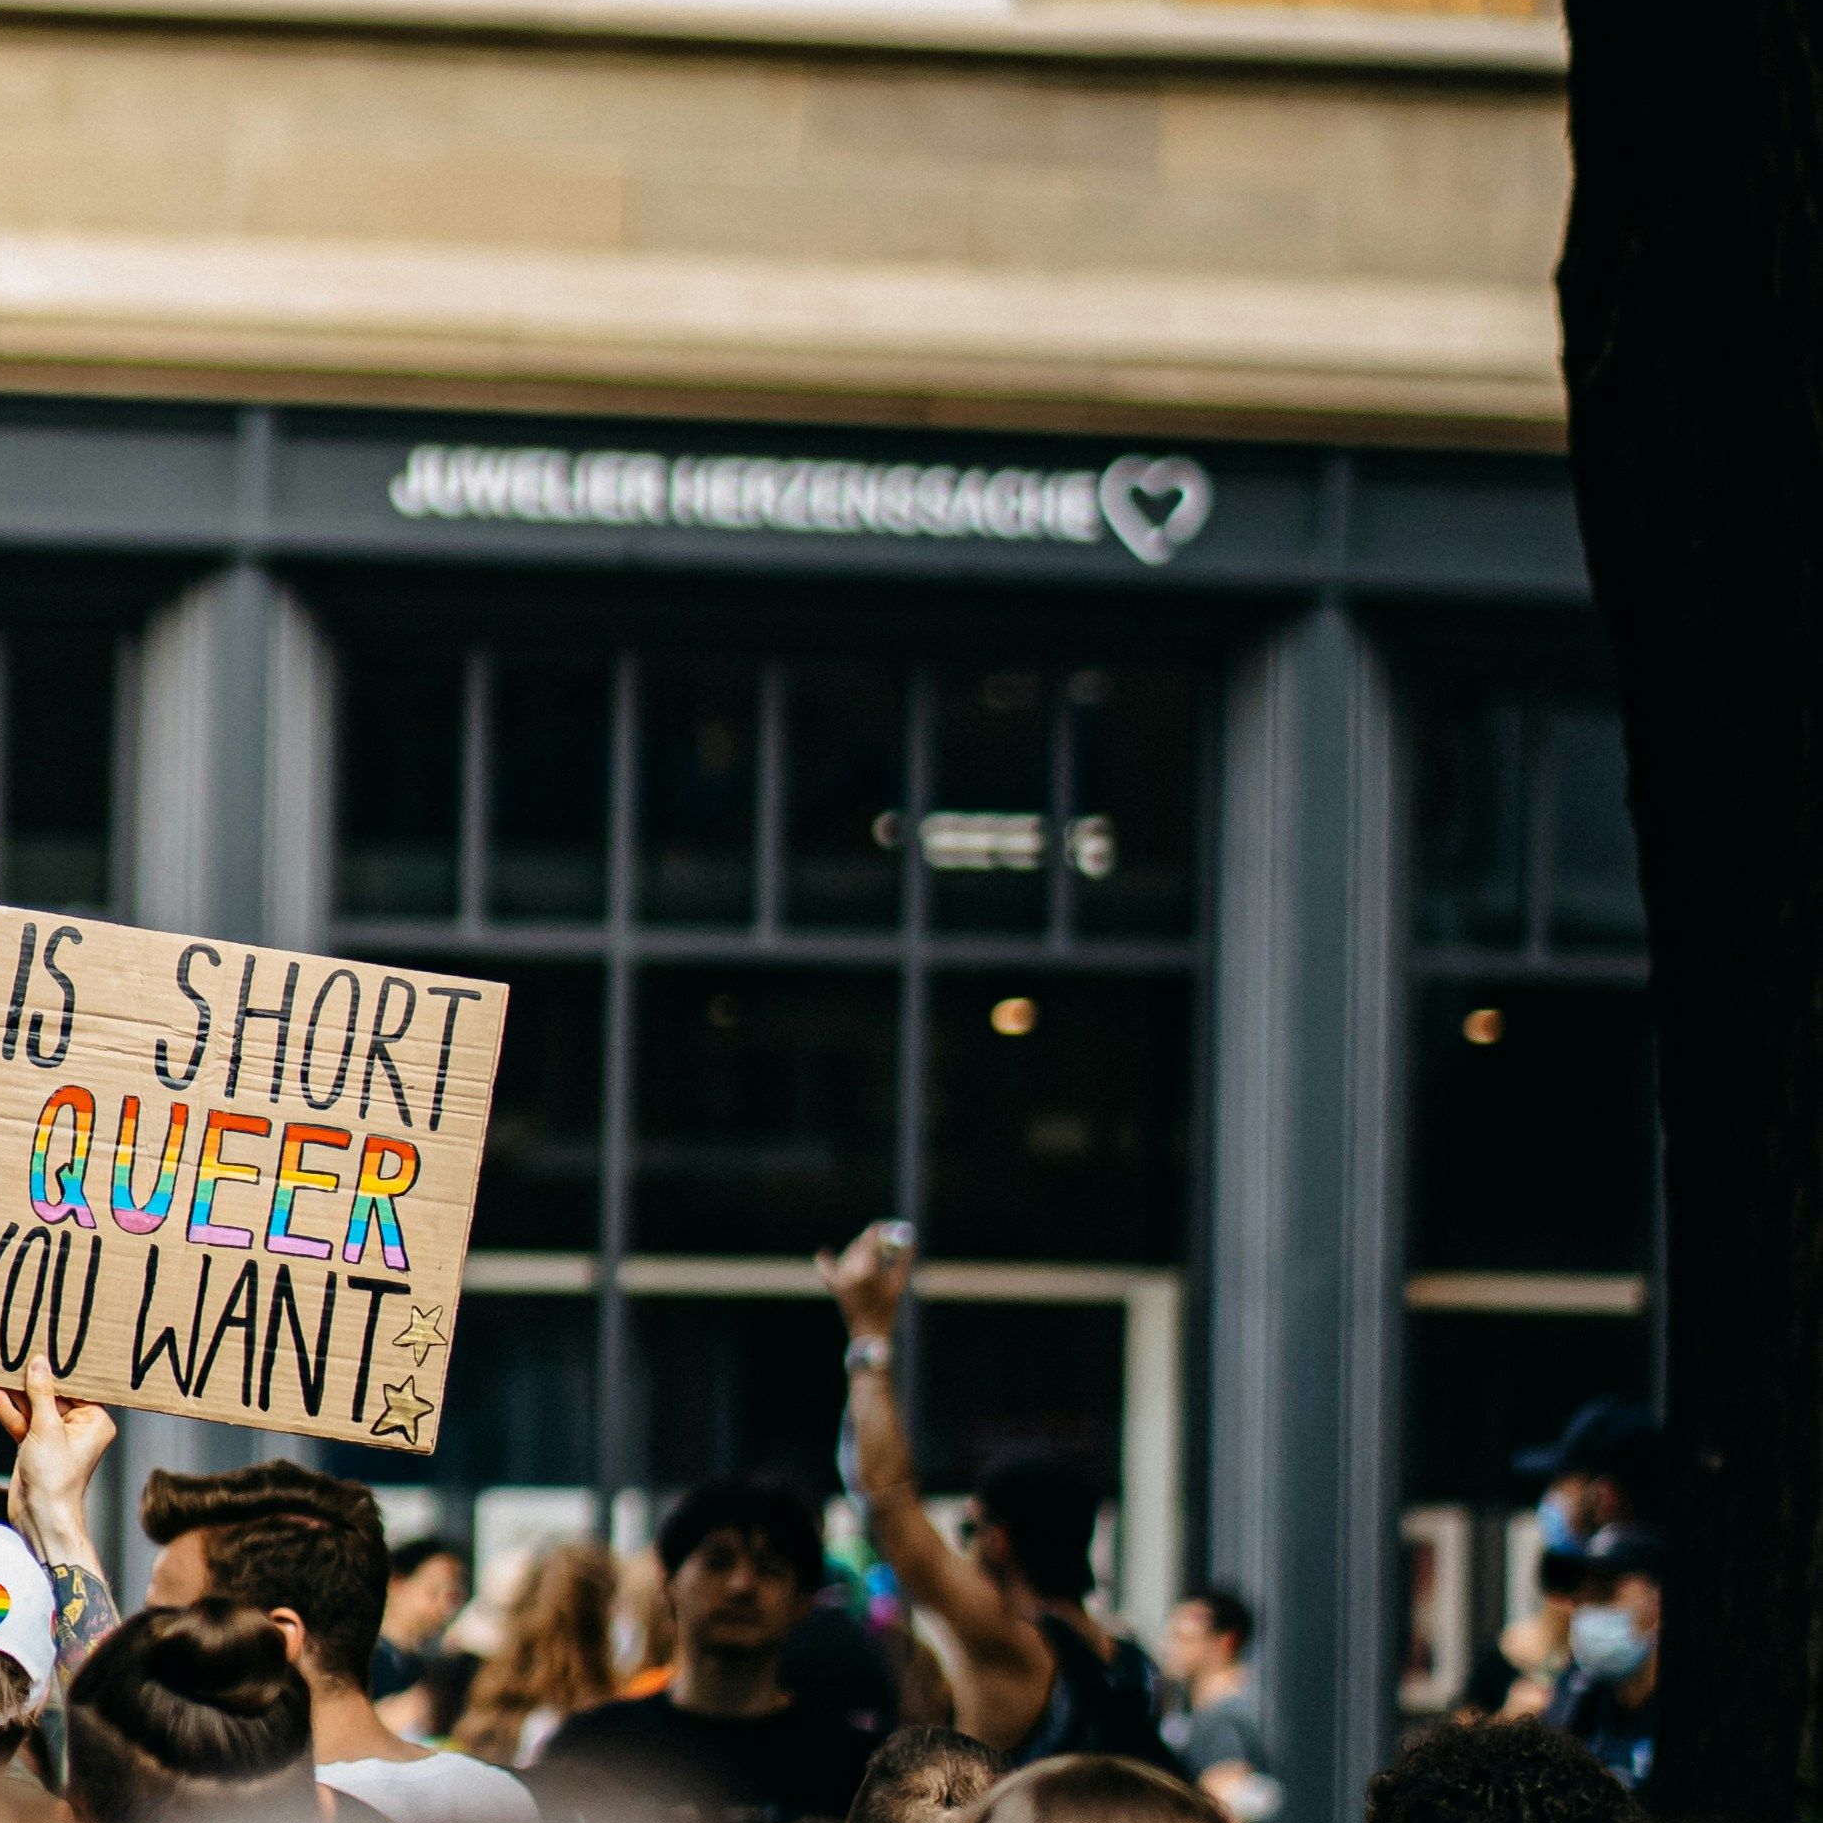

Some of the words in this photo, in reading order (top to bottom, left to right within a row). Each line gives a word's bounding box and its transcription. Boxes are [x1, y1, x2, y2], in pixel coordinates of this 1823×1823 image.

[1, 921, 84, 1069] IS
[153, 942, 483, 1132] SHORT
[29, 1084, 421, 1272] QUEER
[130, 1244, 411, 1424] WANT
